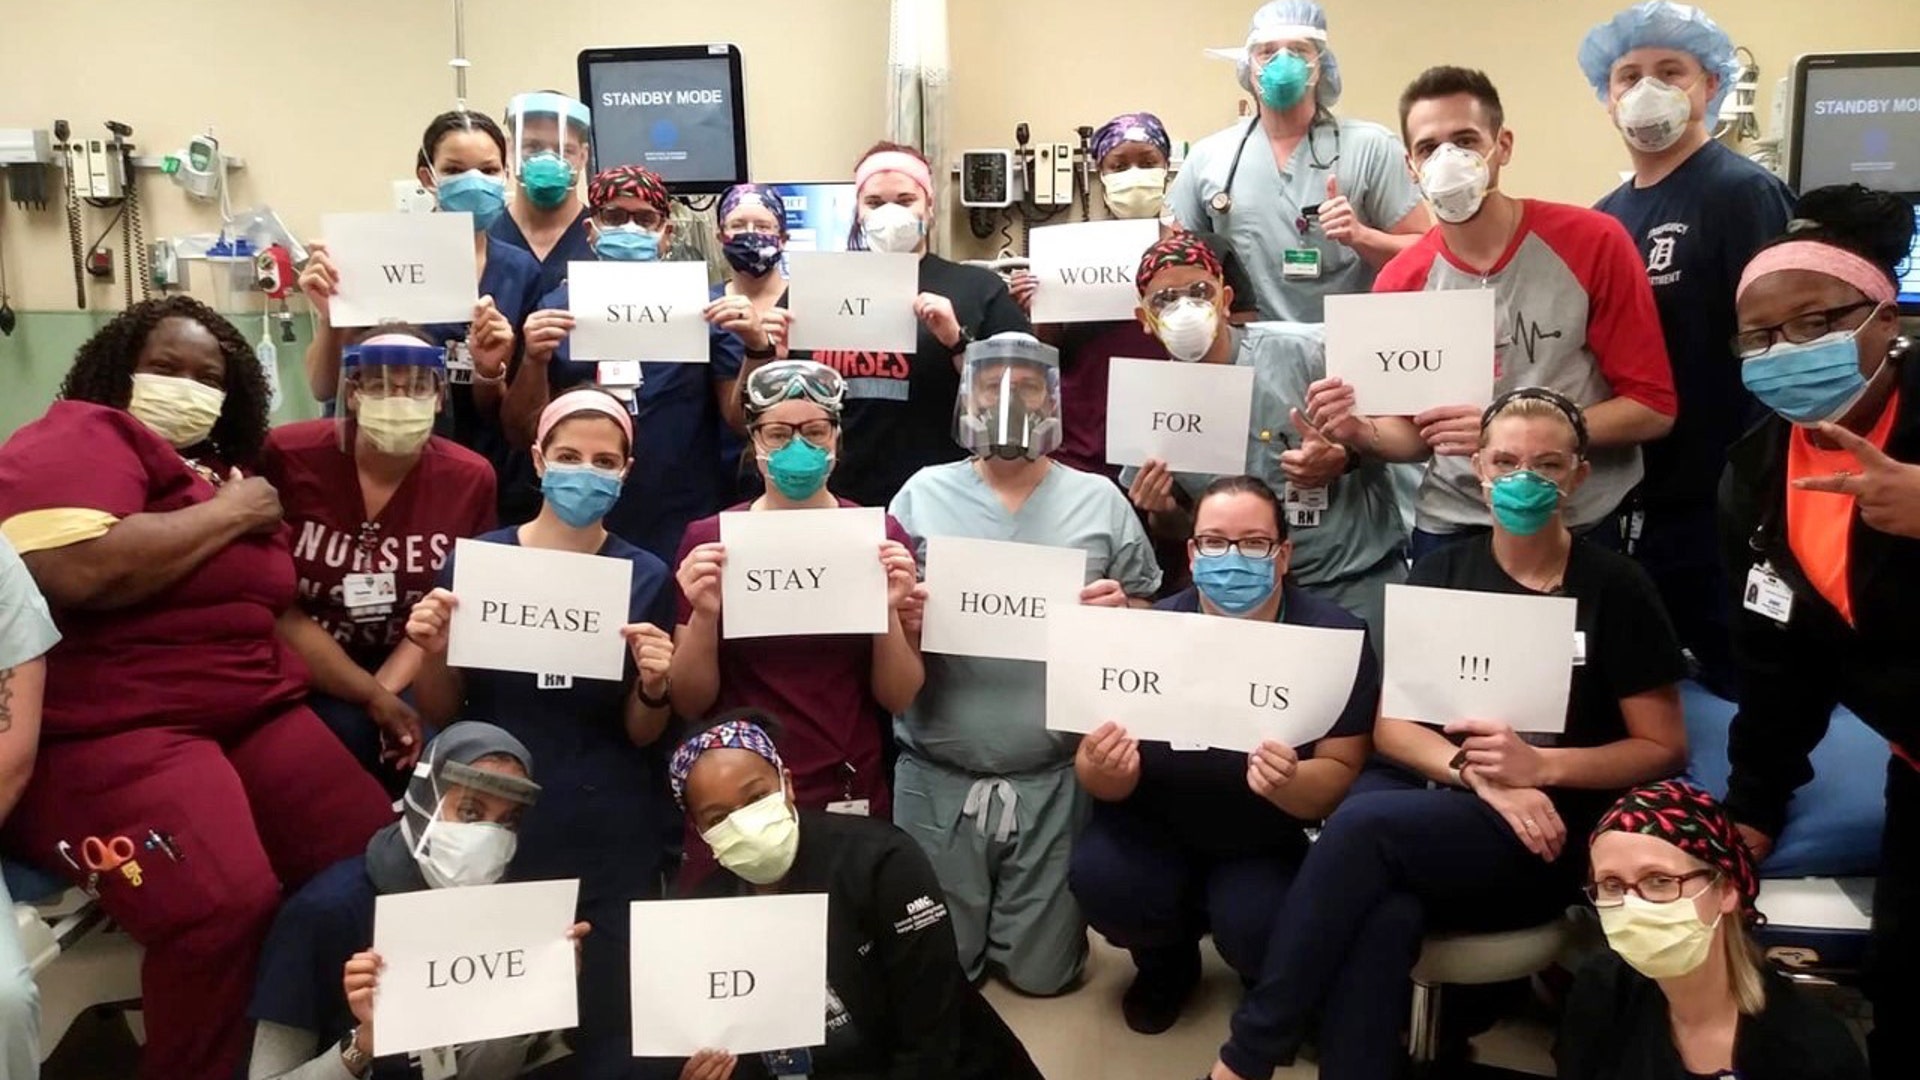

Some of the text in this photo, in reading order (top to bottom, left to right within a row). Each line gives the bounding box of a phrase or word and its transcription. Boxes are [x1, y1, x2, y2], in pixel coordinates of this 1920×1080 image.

[602, 89, 723, 106] STANDBY MODE
[1814, 97, 1920, 115] STANDBY MO
[382, 264, 425, 284] WE
[1060, 265, 1131, 285] WORK
[607, 305, 673, 323] STAY
[838, 297, 870, 316] AT
[1376, 349, 1443, 372] YOU
[1152, 412, 1203, 434] FOR
[1298, 510, 1315, 524] RN
[746, 567, 827, 592] STAY
[960, 592, 1046, 619] HOME
[481, 600, 601, 634] PLEASE
[1459, 655, 1490, 682] !!!
[1100, 667, 1290, 711] FOR US
[427, 949, 526, 989] LOVE
[708, 969, 756, 1000] ED
